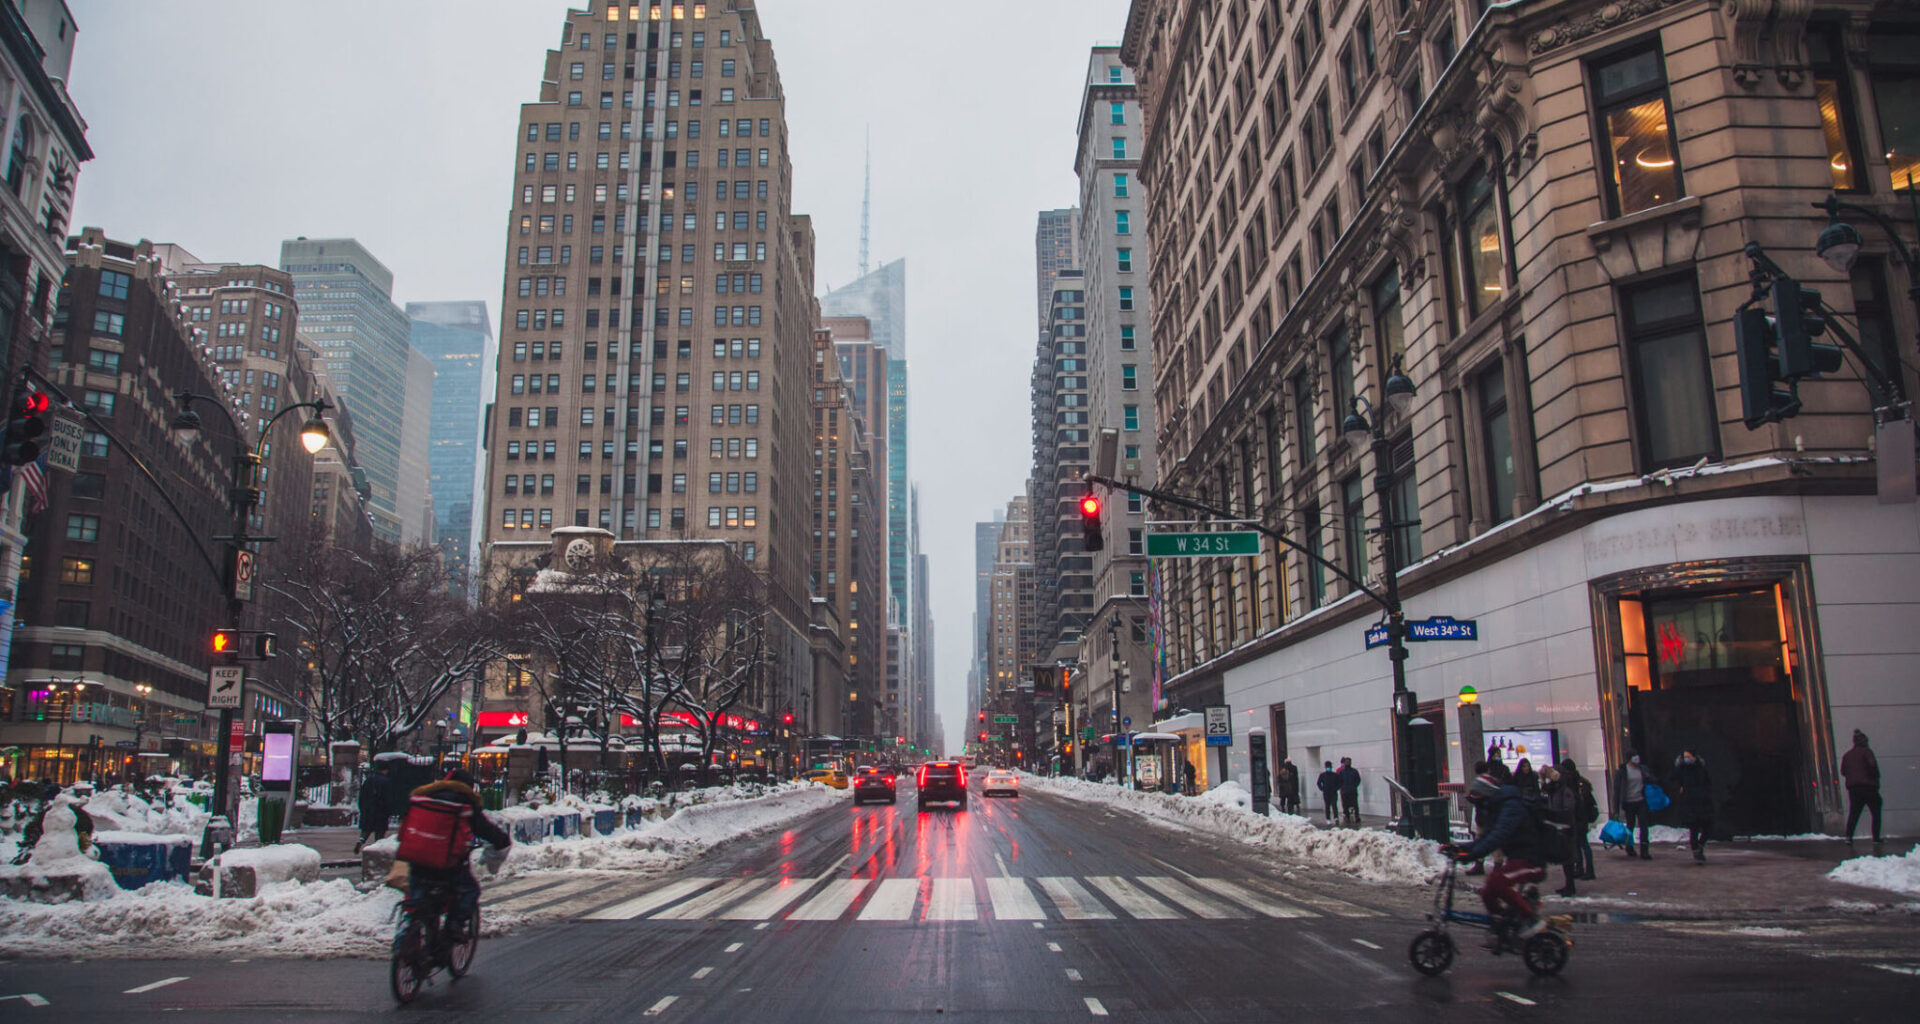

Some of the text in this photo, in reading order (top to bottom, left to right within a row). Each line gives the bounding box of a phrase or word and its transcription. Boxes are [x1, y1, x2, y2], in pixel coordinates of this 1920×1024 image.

[54, 420, 82, 440] BUSES
[53, 435, 78, 452] ONLY
[49, 449, 76, 469] SIGNAL
[1176, 537, 1229, 552] W 34 St
[1414, 624, 1471, 636] West 34th St
[1368, 631, 1389, 644] Sixth Ave
[215, 670, 238, 678] KEEP
[211, 696, 238, 704] RIGHT
[1209, 722, 1227, 733] 25
